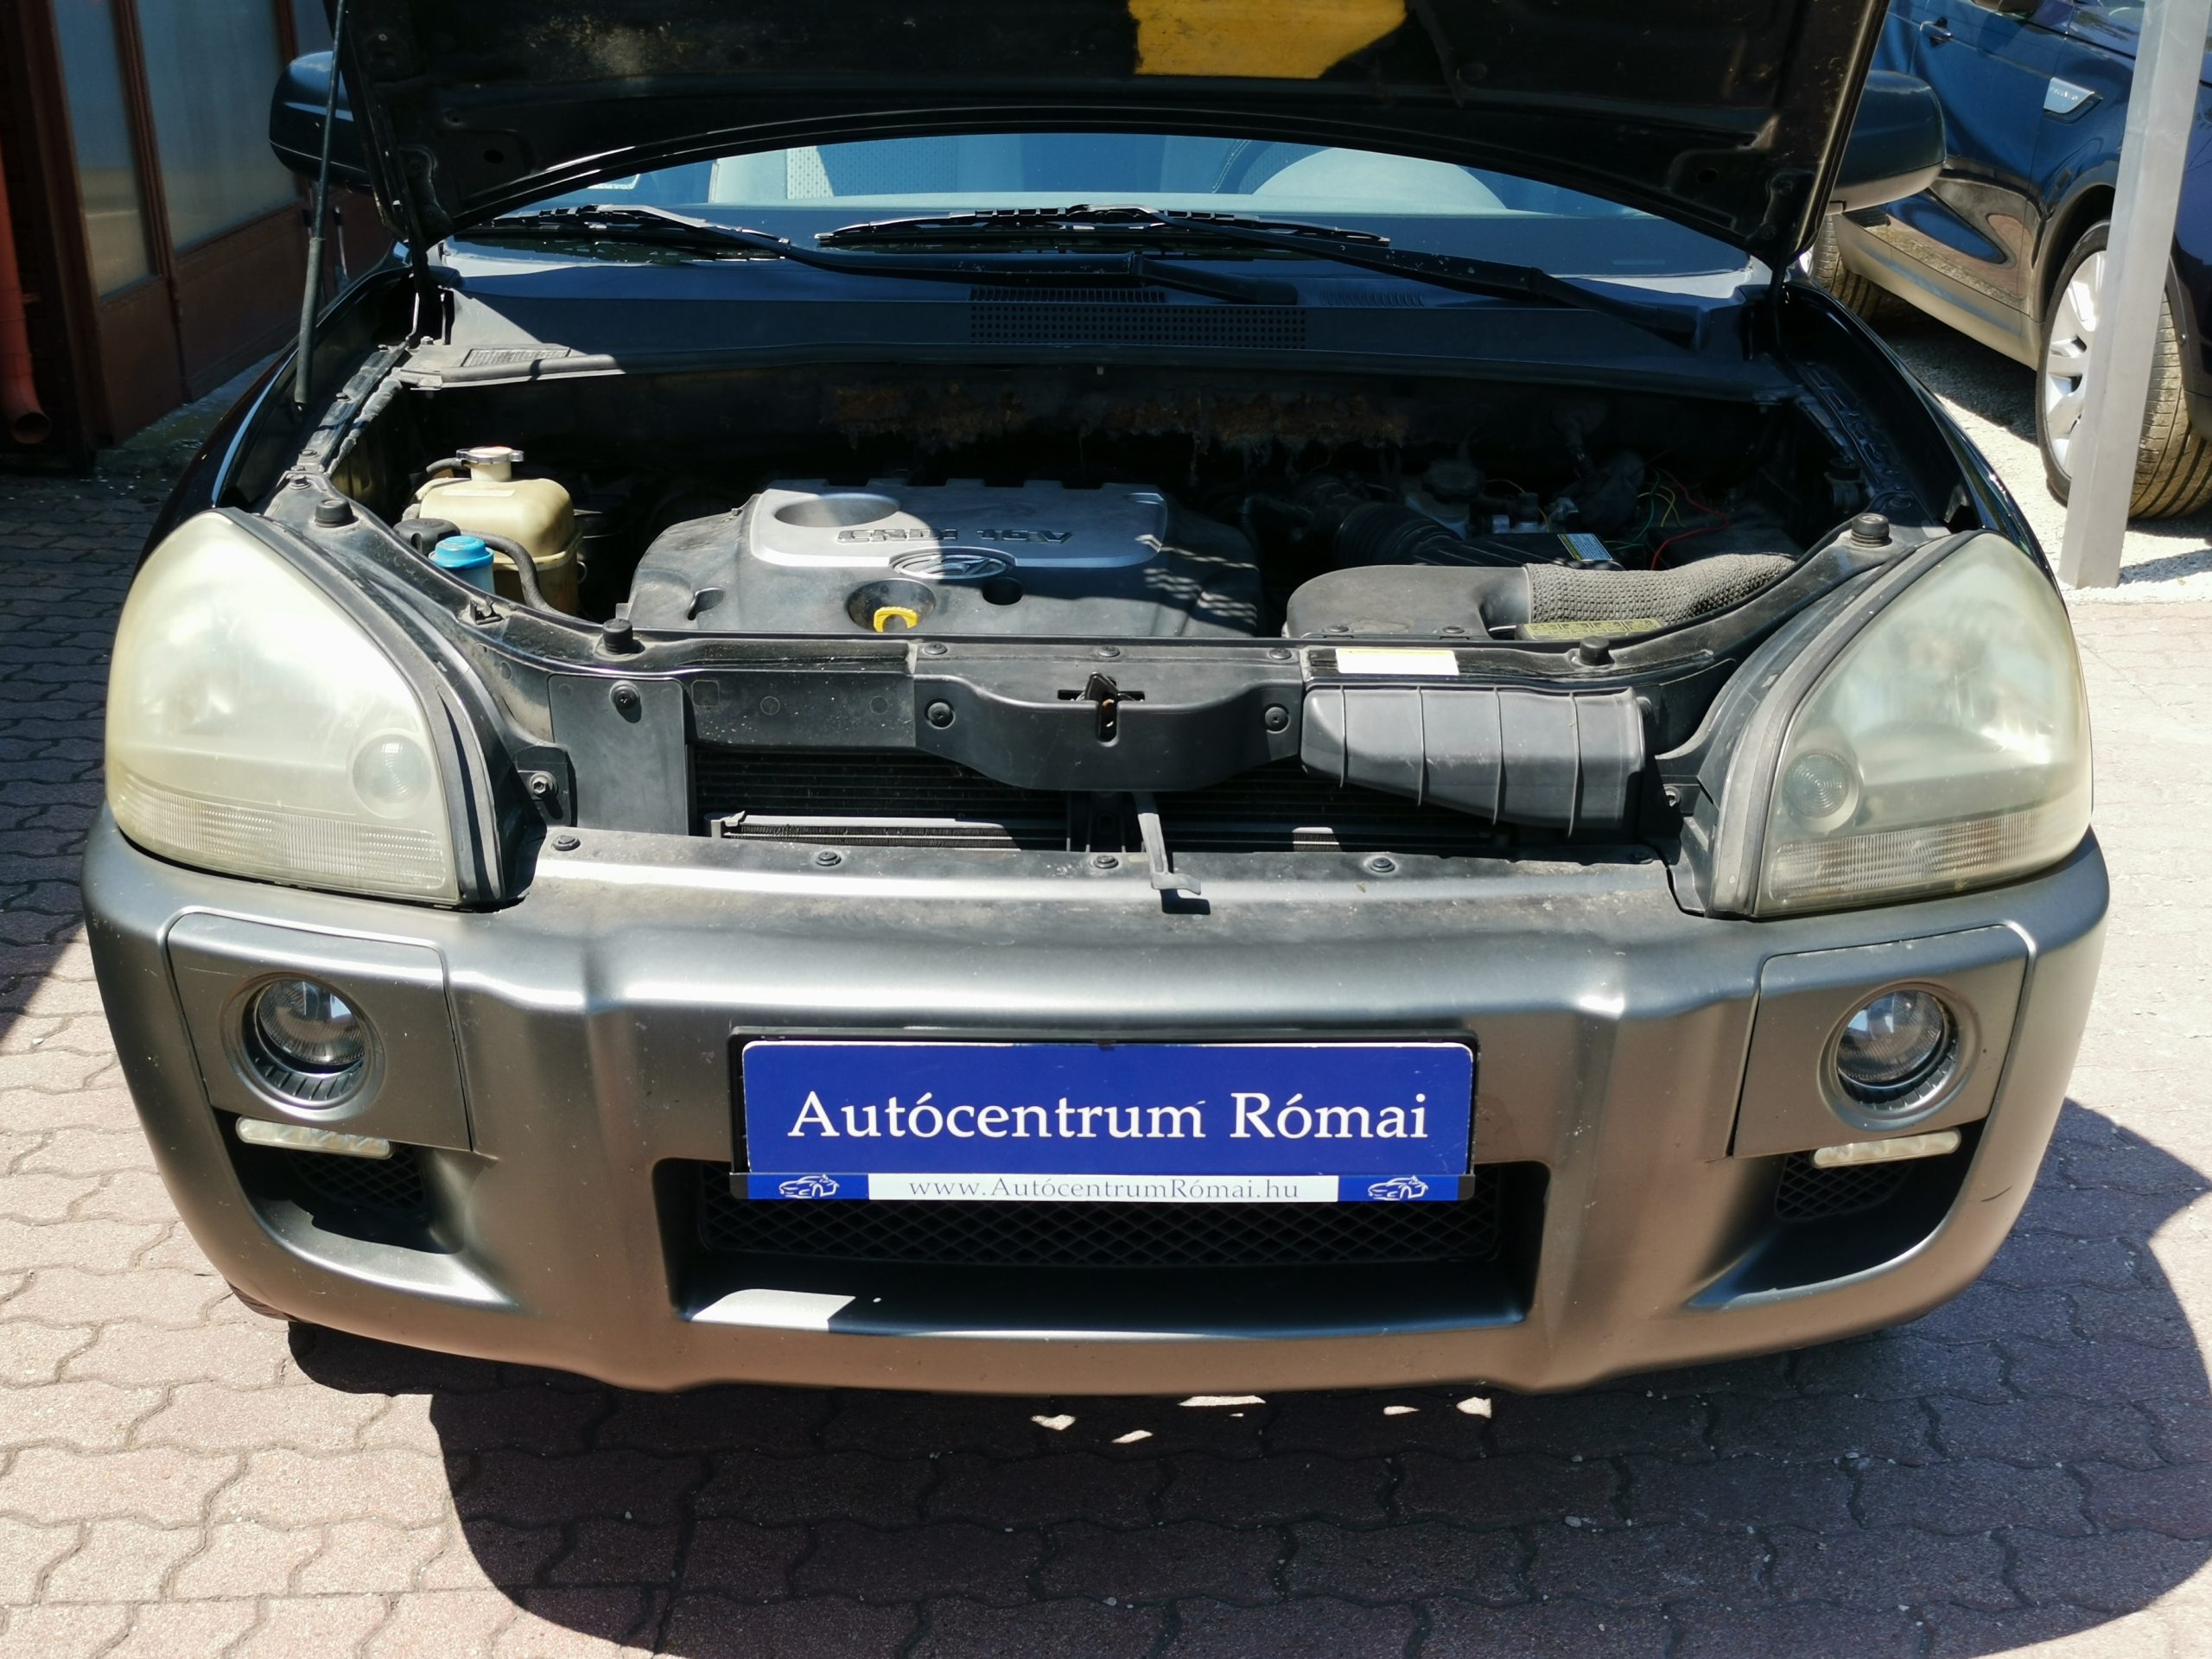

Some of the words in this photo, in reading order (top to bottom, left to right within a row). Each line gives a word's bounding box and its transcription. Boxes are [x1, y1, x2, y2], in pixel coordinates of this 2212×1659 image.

[976, 529, 1073, 544] 16V
[786, 1090, 1206, 1140] Autócentrum
[1229, 1091, 1429, 1140] Római
[908, 1177, 1299, 1199] www.AutócentrumRómai.hu
